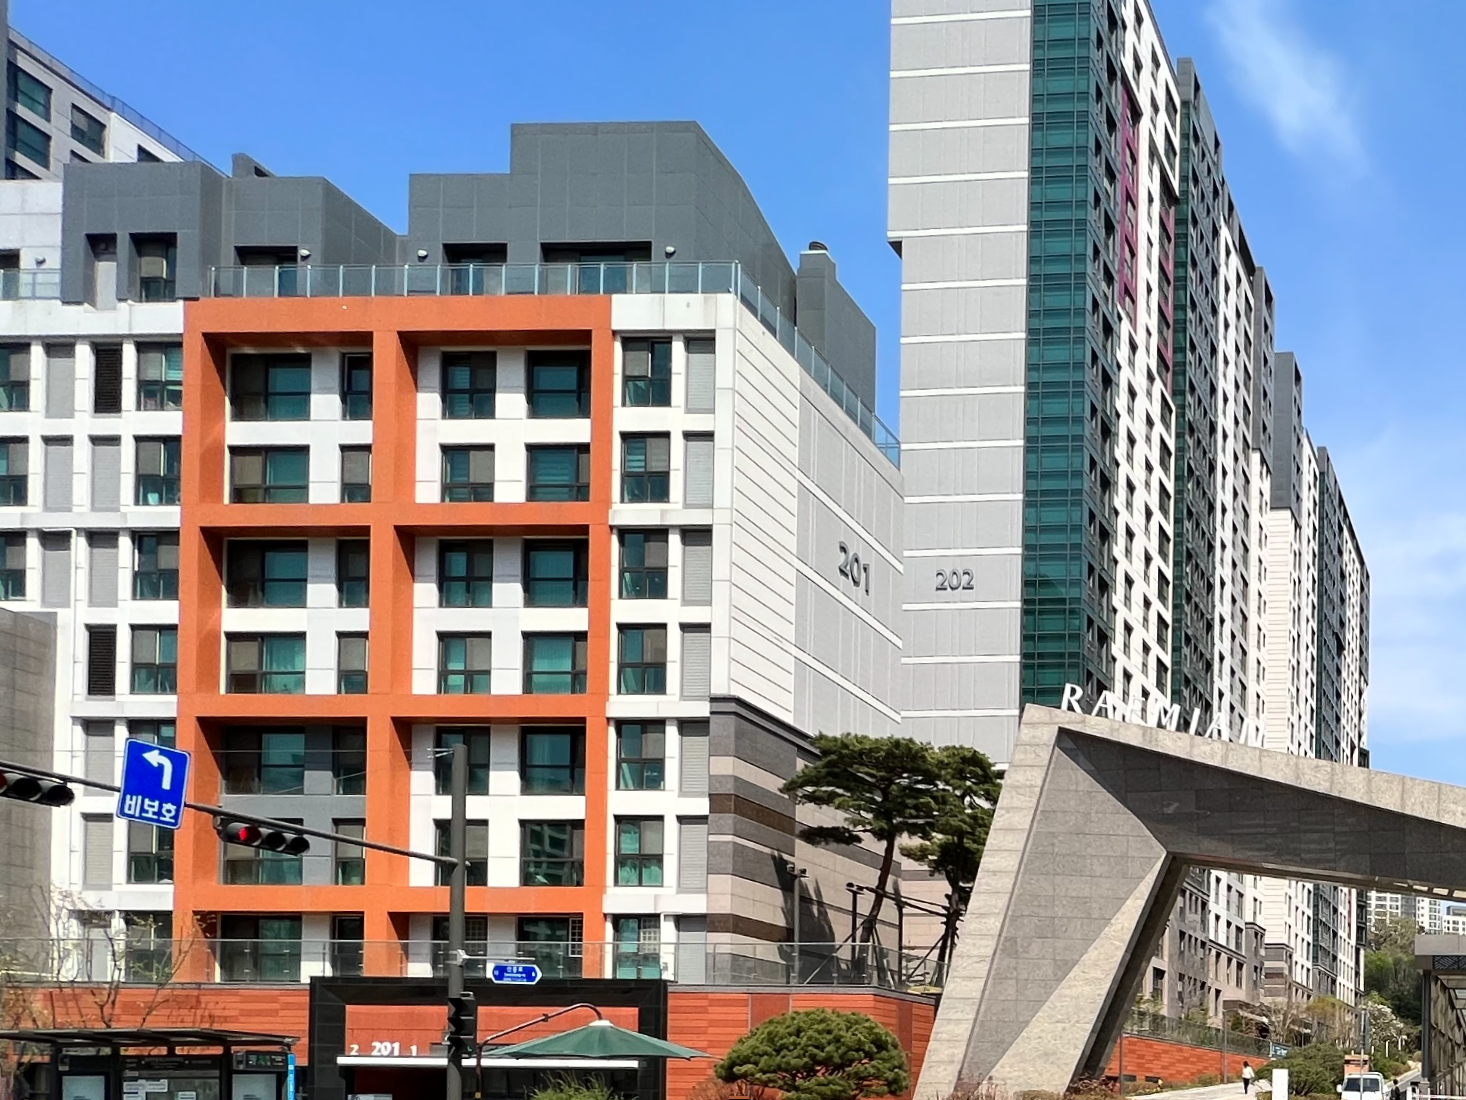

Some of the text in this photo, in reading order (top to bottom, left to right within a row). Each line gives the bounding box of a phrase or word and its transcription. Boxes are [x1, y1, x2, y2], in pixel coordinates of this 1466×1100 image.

[838, 541, 871, 596] 201
[935, 569, 974, 591] 202
[1060, 683, 1265, 748] RAEMIAN
[124, 794, 176, 822] 비보호
[349, 1041, 418, 1056] 2 201 1
